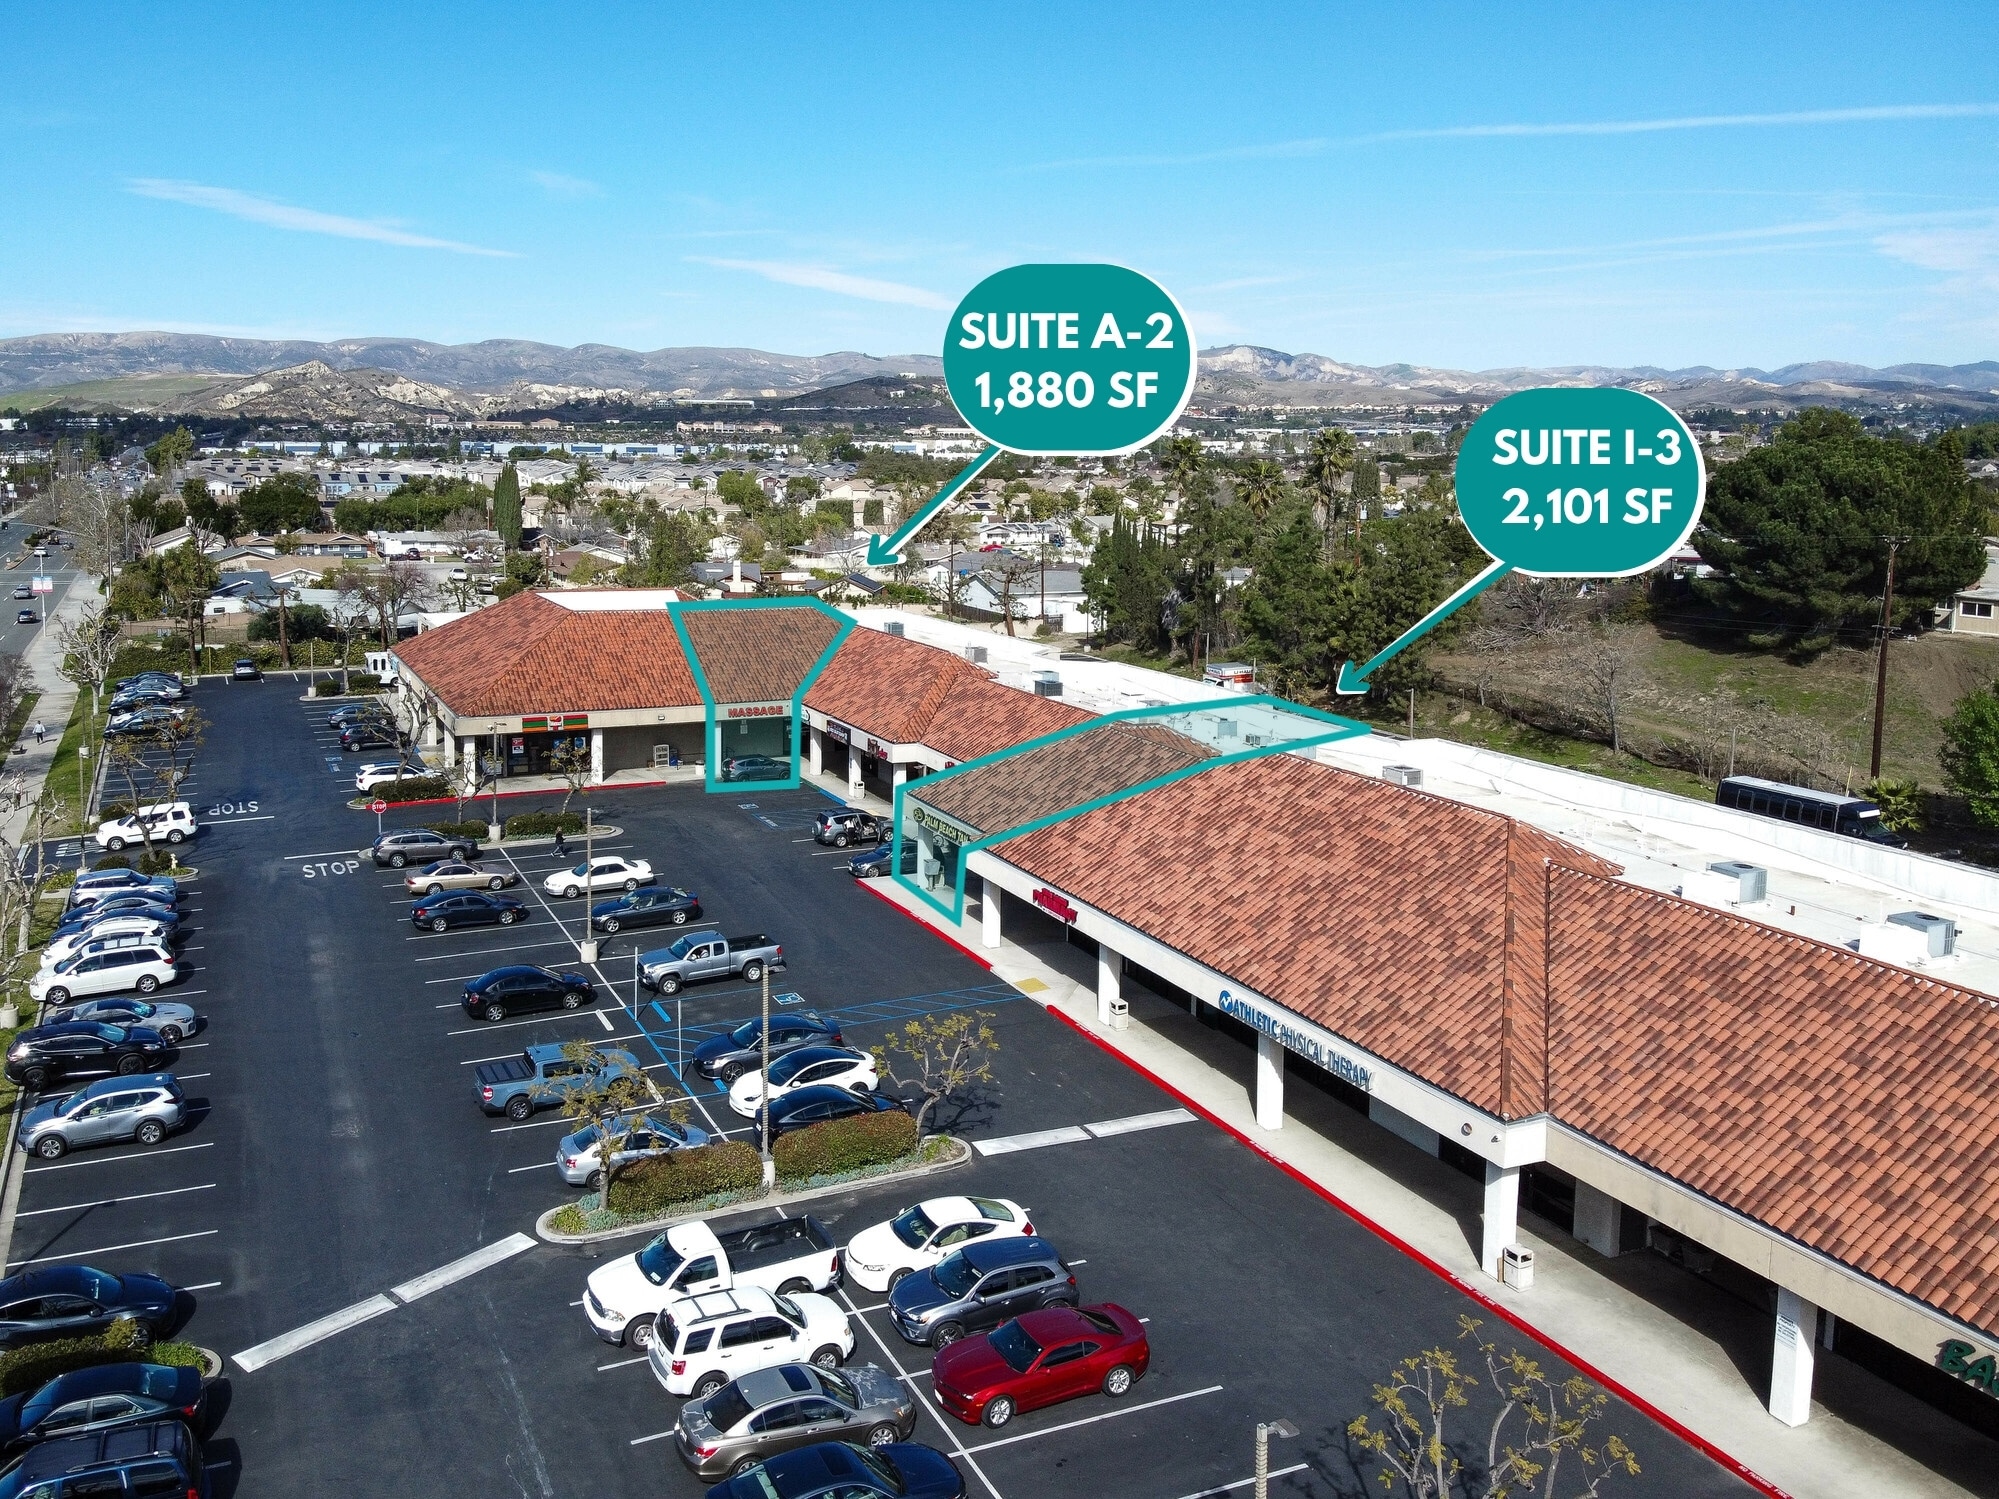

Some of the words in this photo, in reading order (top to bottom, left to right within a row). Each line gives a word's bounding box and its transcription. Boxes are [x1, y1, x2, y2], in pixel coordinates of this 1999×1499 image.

[728, 706, 784, 718] MASSAGE
[208, 801, 259, 816] STOP
[924, 814, 940, 831] PALM
[938, 821, 958, 842] BEACH
[957, 830, 972, 843] TAN
[302, 860, 360, 879] STOP
[1233, 998, 1279, 1038] ATHLETIC
[1279, 1022, 1327, 1067] PHYSICAL
[1327, 1049, 1374, 1092] THERAPY
